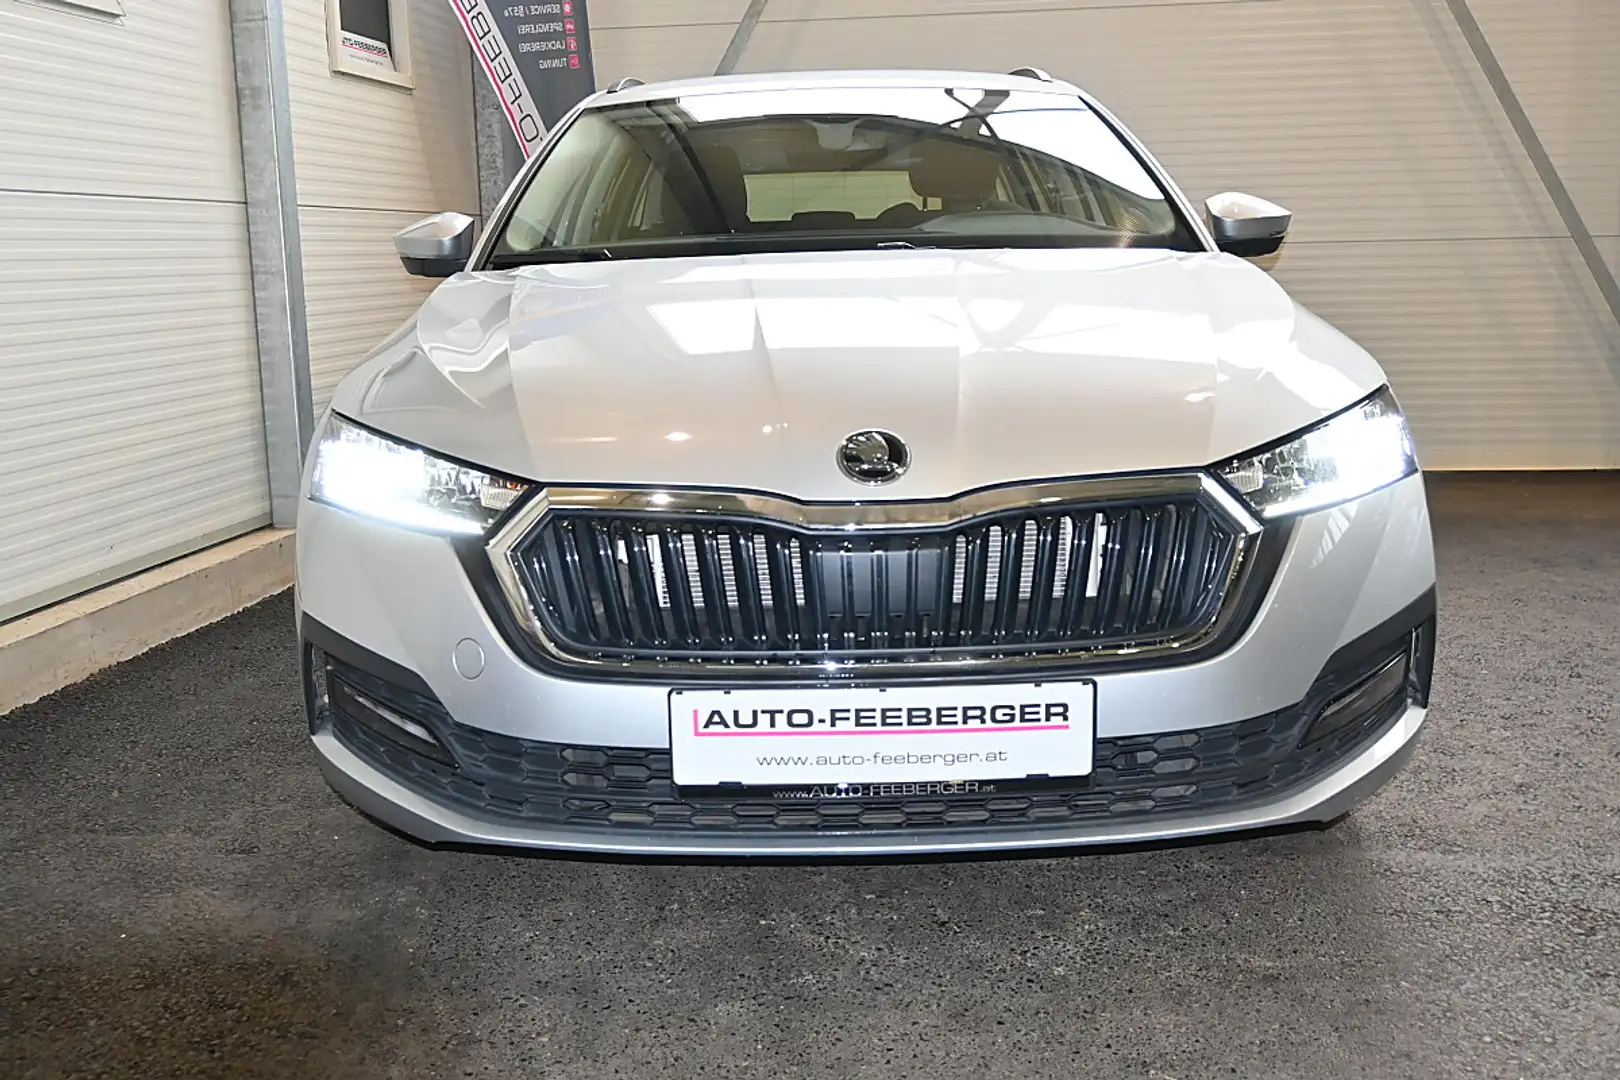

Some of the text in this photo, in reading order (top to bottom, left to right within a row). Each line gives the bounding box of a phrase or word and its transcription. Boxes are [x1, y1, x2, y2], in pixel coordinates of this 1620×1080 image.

[702, 702, 1070, 729] AUTO-FEEBERGER
[756, 750, 1009, 767] www.auto-feeberger.at
[772, 781, 997, 799] www.AUTO-FEEBERGER.at
